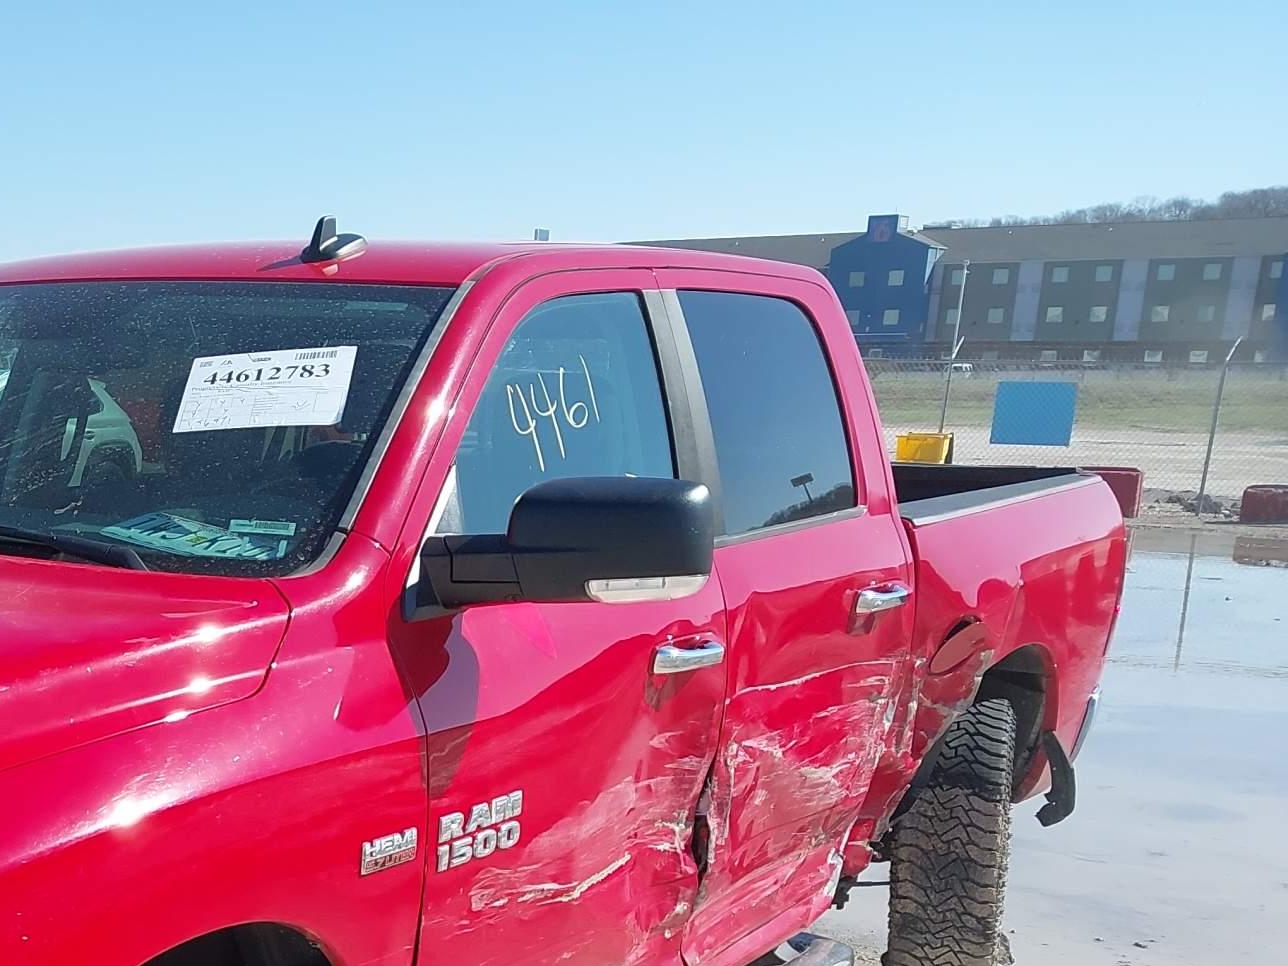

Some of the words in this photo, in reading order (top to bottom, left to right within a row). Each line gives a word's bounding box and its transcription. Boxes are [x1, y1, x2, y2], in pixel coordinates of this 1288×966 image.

[203, 363, 330, 385] 44612783
[506, 354, 600, 472] 4461
[439, 790, 523, 843] RAM
[362, 827, 417, 860] HEMI
[437, 820, 521, 872] 1500
